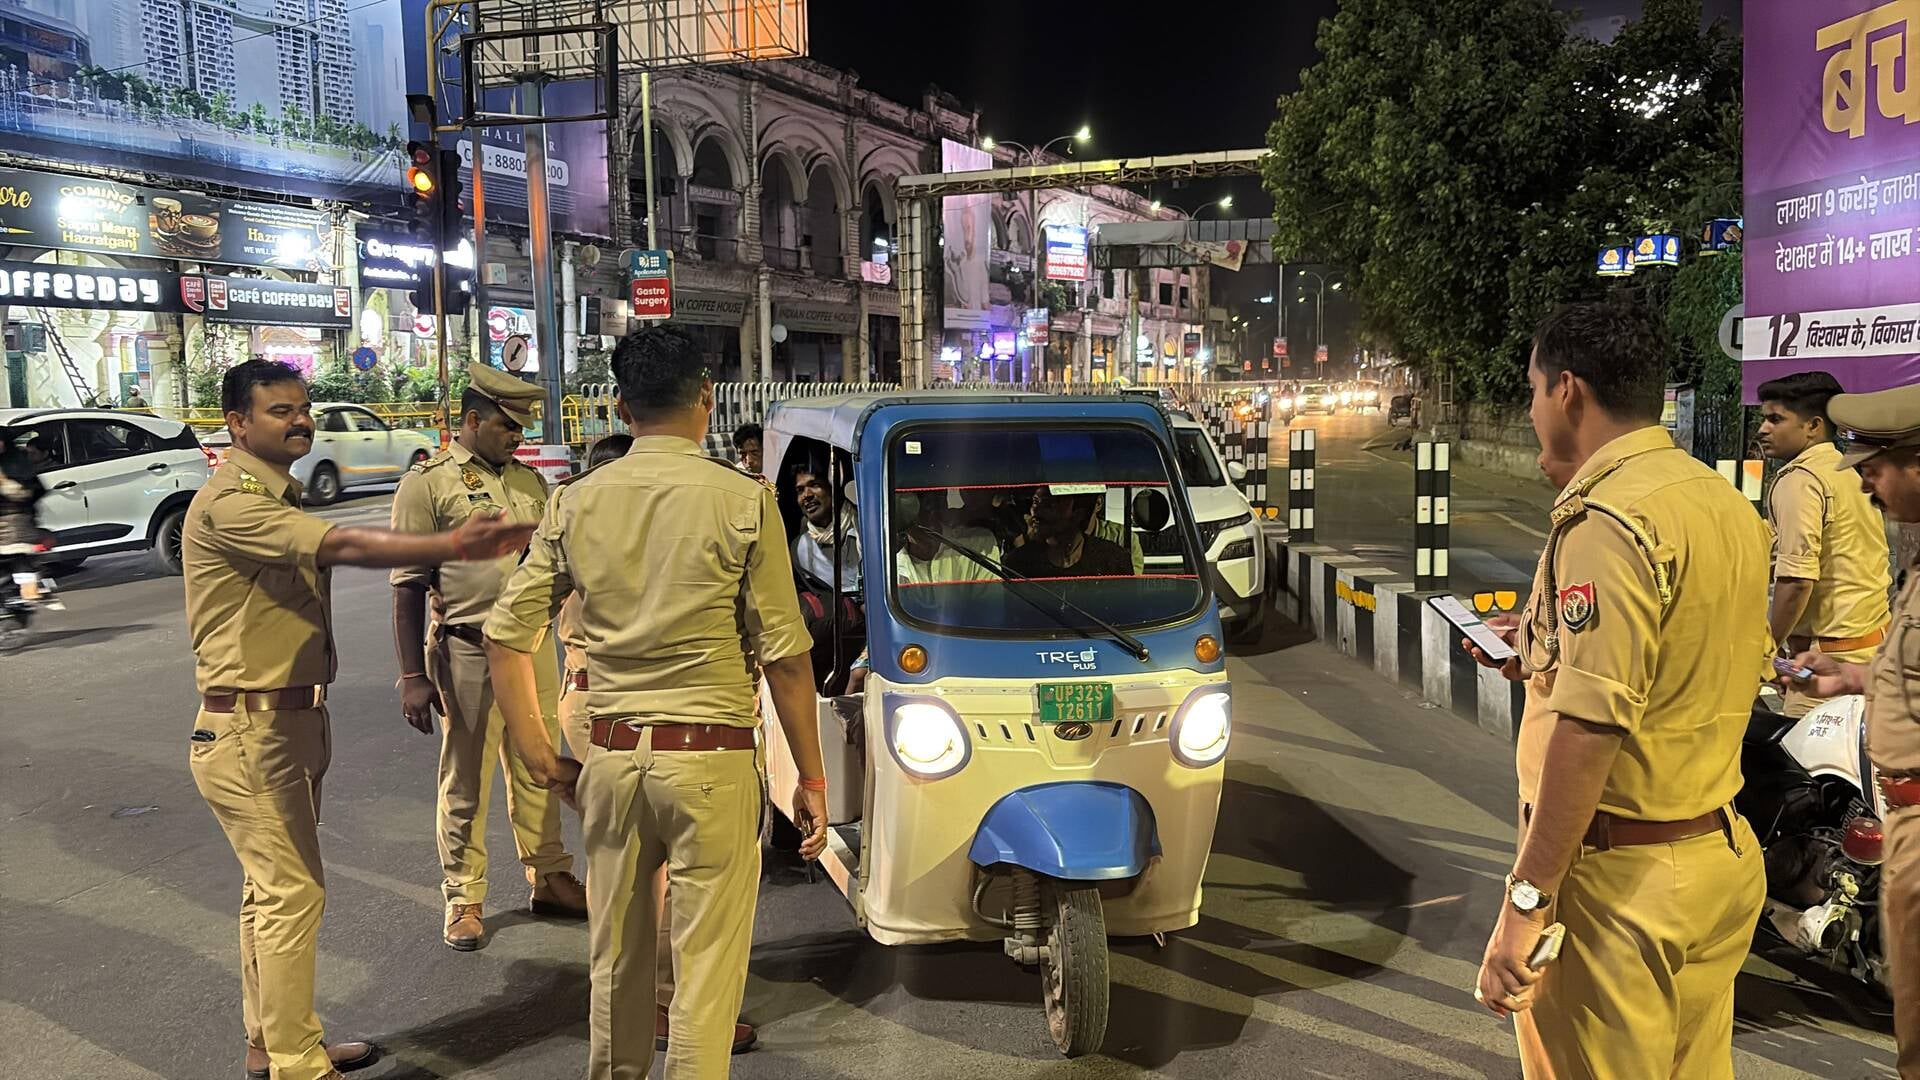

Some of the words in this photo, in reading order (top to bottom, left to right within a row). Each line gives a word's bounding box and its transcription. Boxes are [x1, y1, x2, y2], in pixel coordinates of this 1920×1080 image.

[59, 185, 133, 206] COMING
[1776, 193, 1822, 225] लगभग
[1825, 189, 1835, 216] 9
[1838, 175, 1880, 215] करोड़
[62, 230, 138, 252] Hazratganj
[1775, 241, 1818, 273] देशभर
[1819, 233, 1835, 267] में
[1837, 236, 1866, 265] 14+
[1869, 227, 1913, 261] लाख
[635, 297, 669, 307] Surgery
[636, 288, 666, 296] Gastro
[687, 299, 717, 312] COFFEE
[717, 302, 743, 314] HOUSE
[1769, 313, 1801, 358] 12
[1806, 320, 1851, 348] विश्वास
[1870, 315, 1917, 346] विकास
[1055, 684, 1103, 702] UP32S
[1056, 702, 1103, 719] T2611
